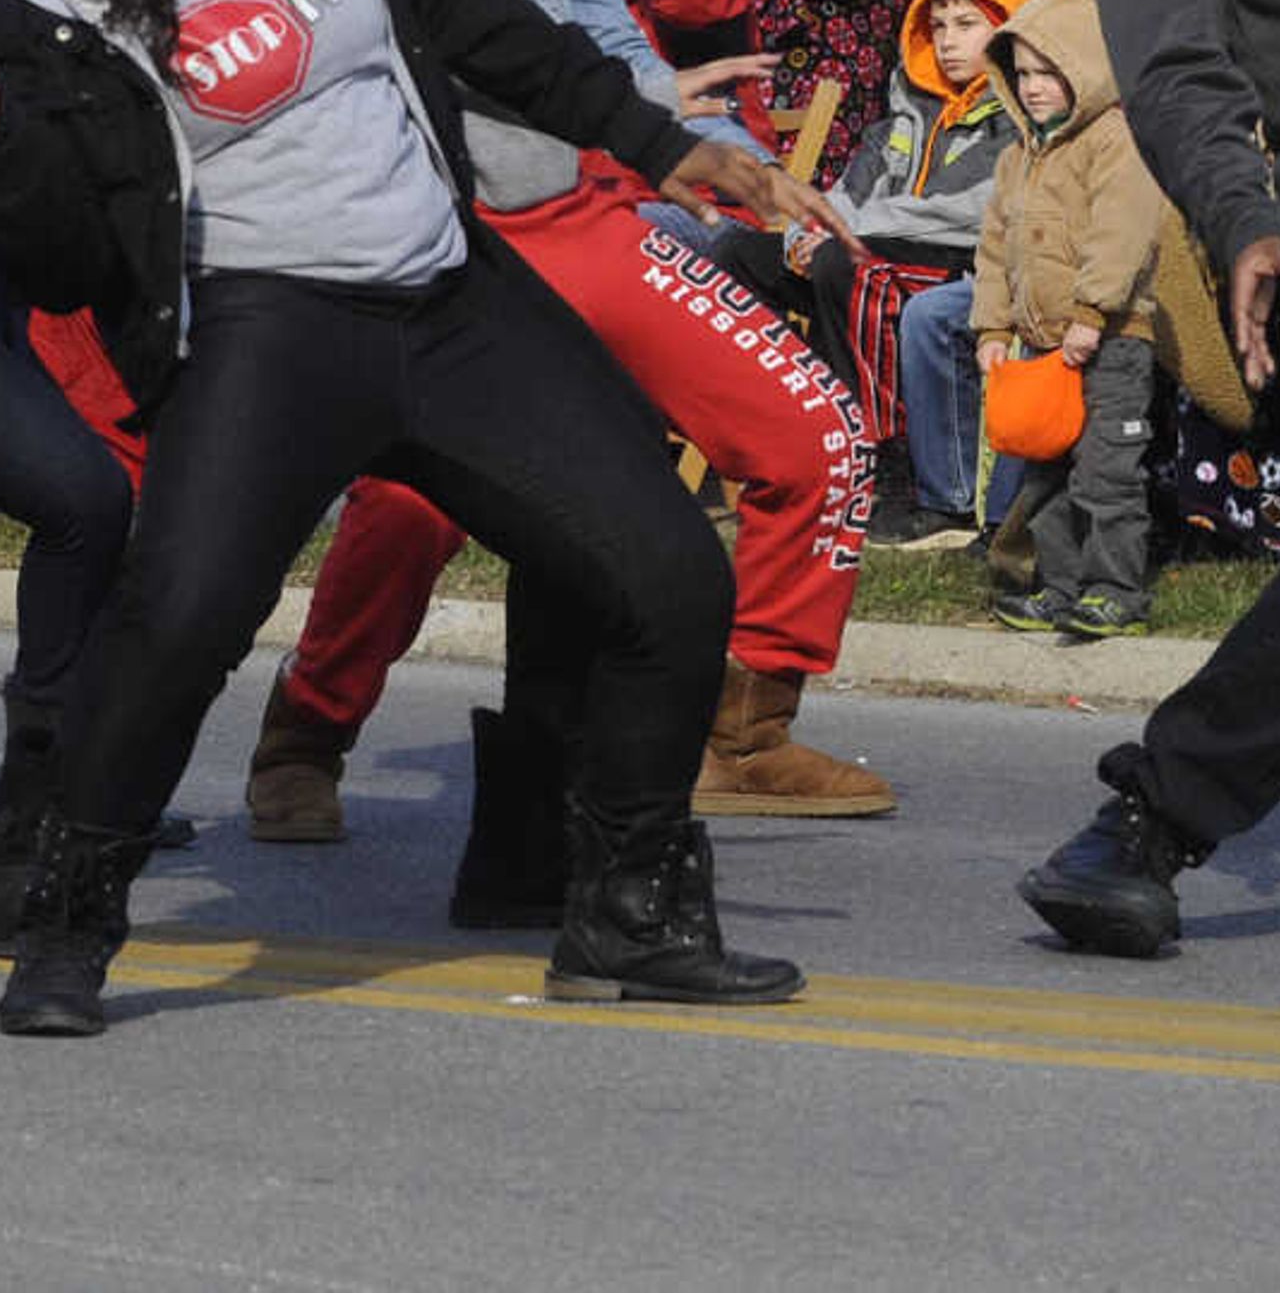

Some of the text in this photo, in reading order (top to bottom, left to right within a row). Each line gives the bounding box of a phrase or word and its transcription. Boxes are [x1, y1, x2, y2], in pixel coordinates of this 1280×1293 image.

[184, 11, 287, 93] STOP
[641, 264, 851, 557] MISSOURI STATE
